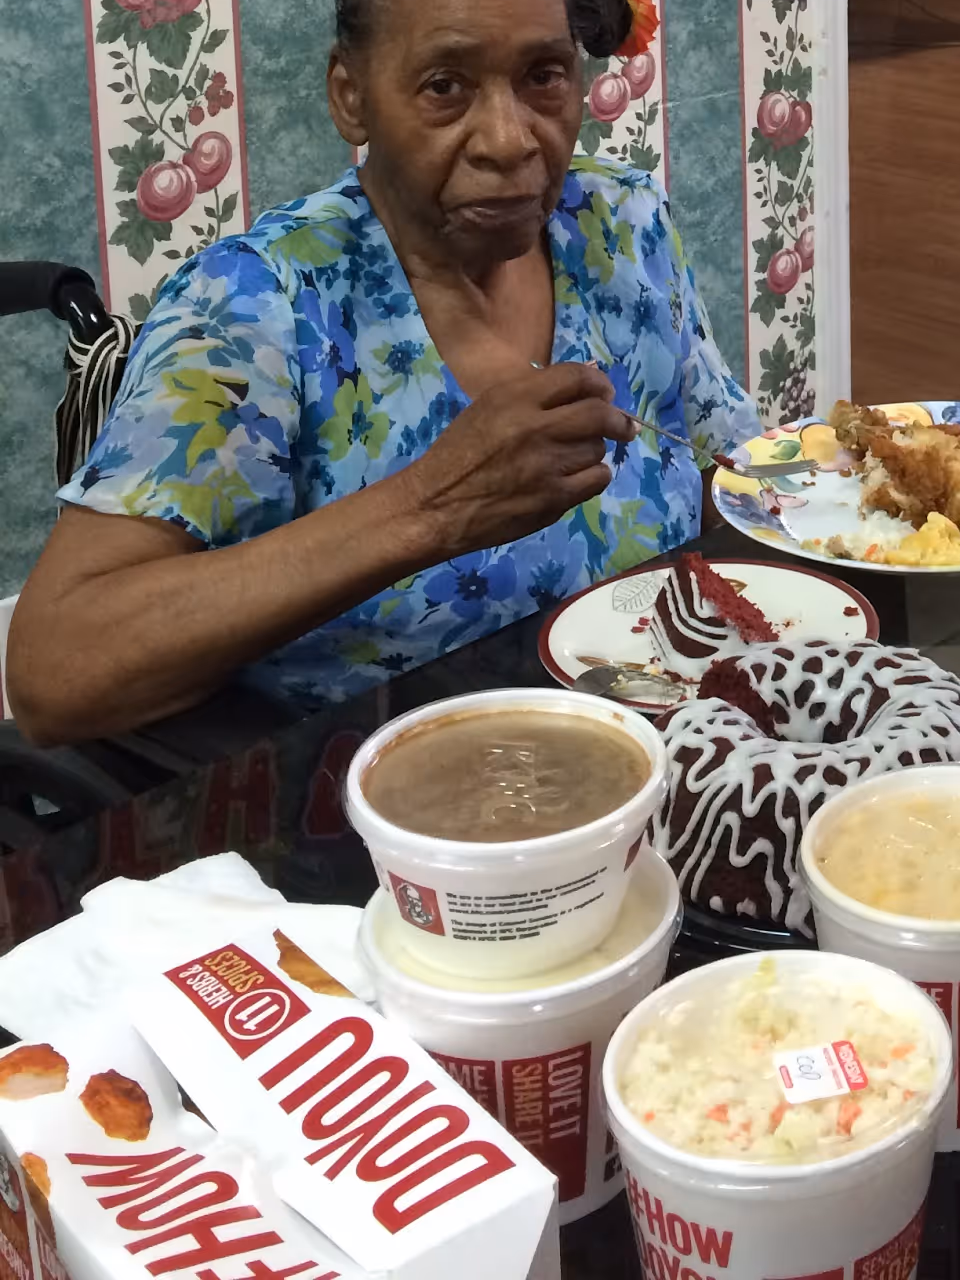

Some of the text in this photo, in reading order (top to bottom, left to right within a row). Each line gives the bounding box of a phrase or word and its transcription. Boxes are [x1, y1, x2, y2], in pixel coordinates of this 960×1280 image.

[186, 971, 235, 1010] HERBS
[204, 950, 265, 994] SPICES
[234, 995, 281, 1031] 11
[511, 1062, 544, 1129] SHARE
[548, 1050, 585, 1140] LOVE IT
